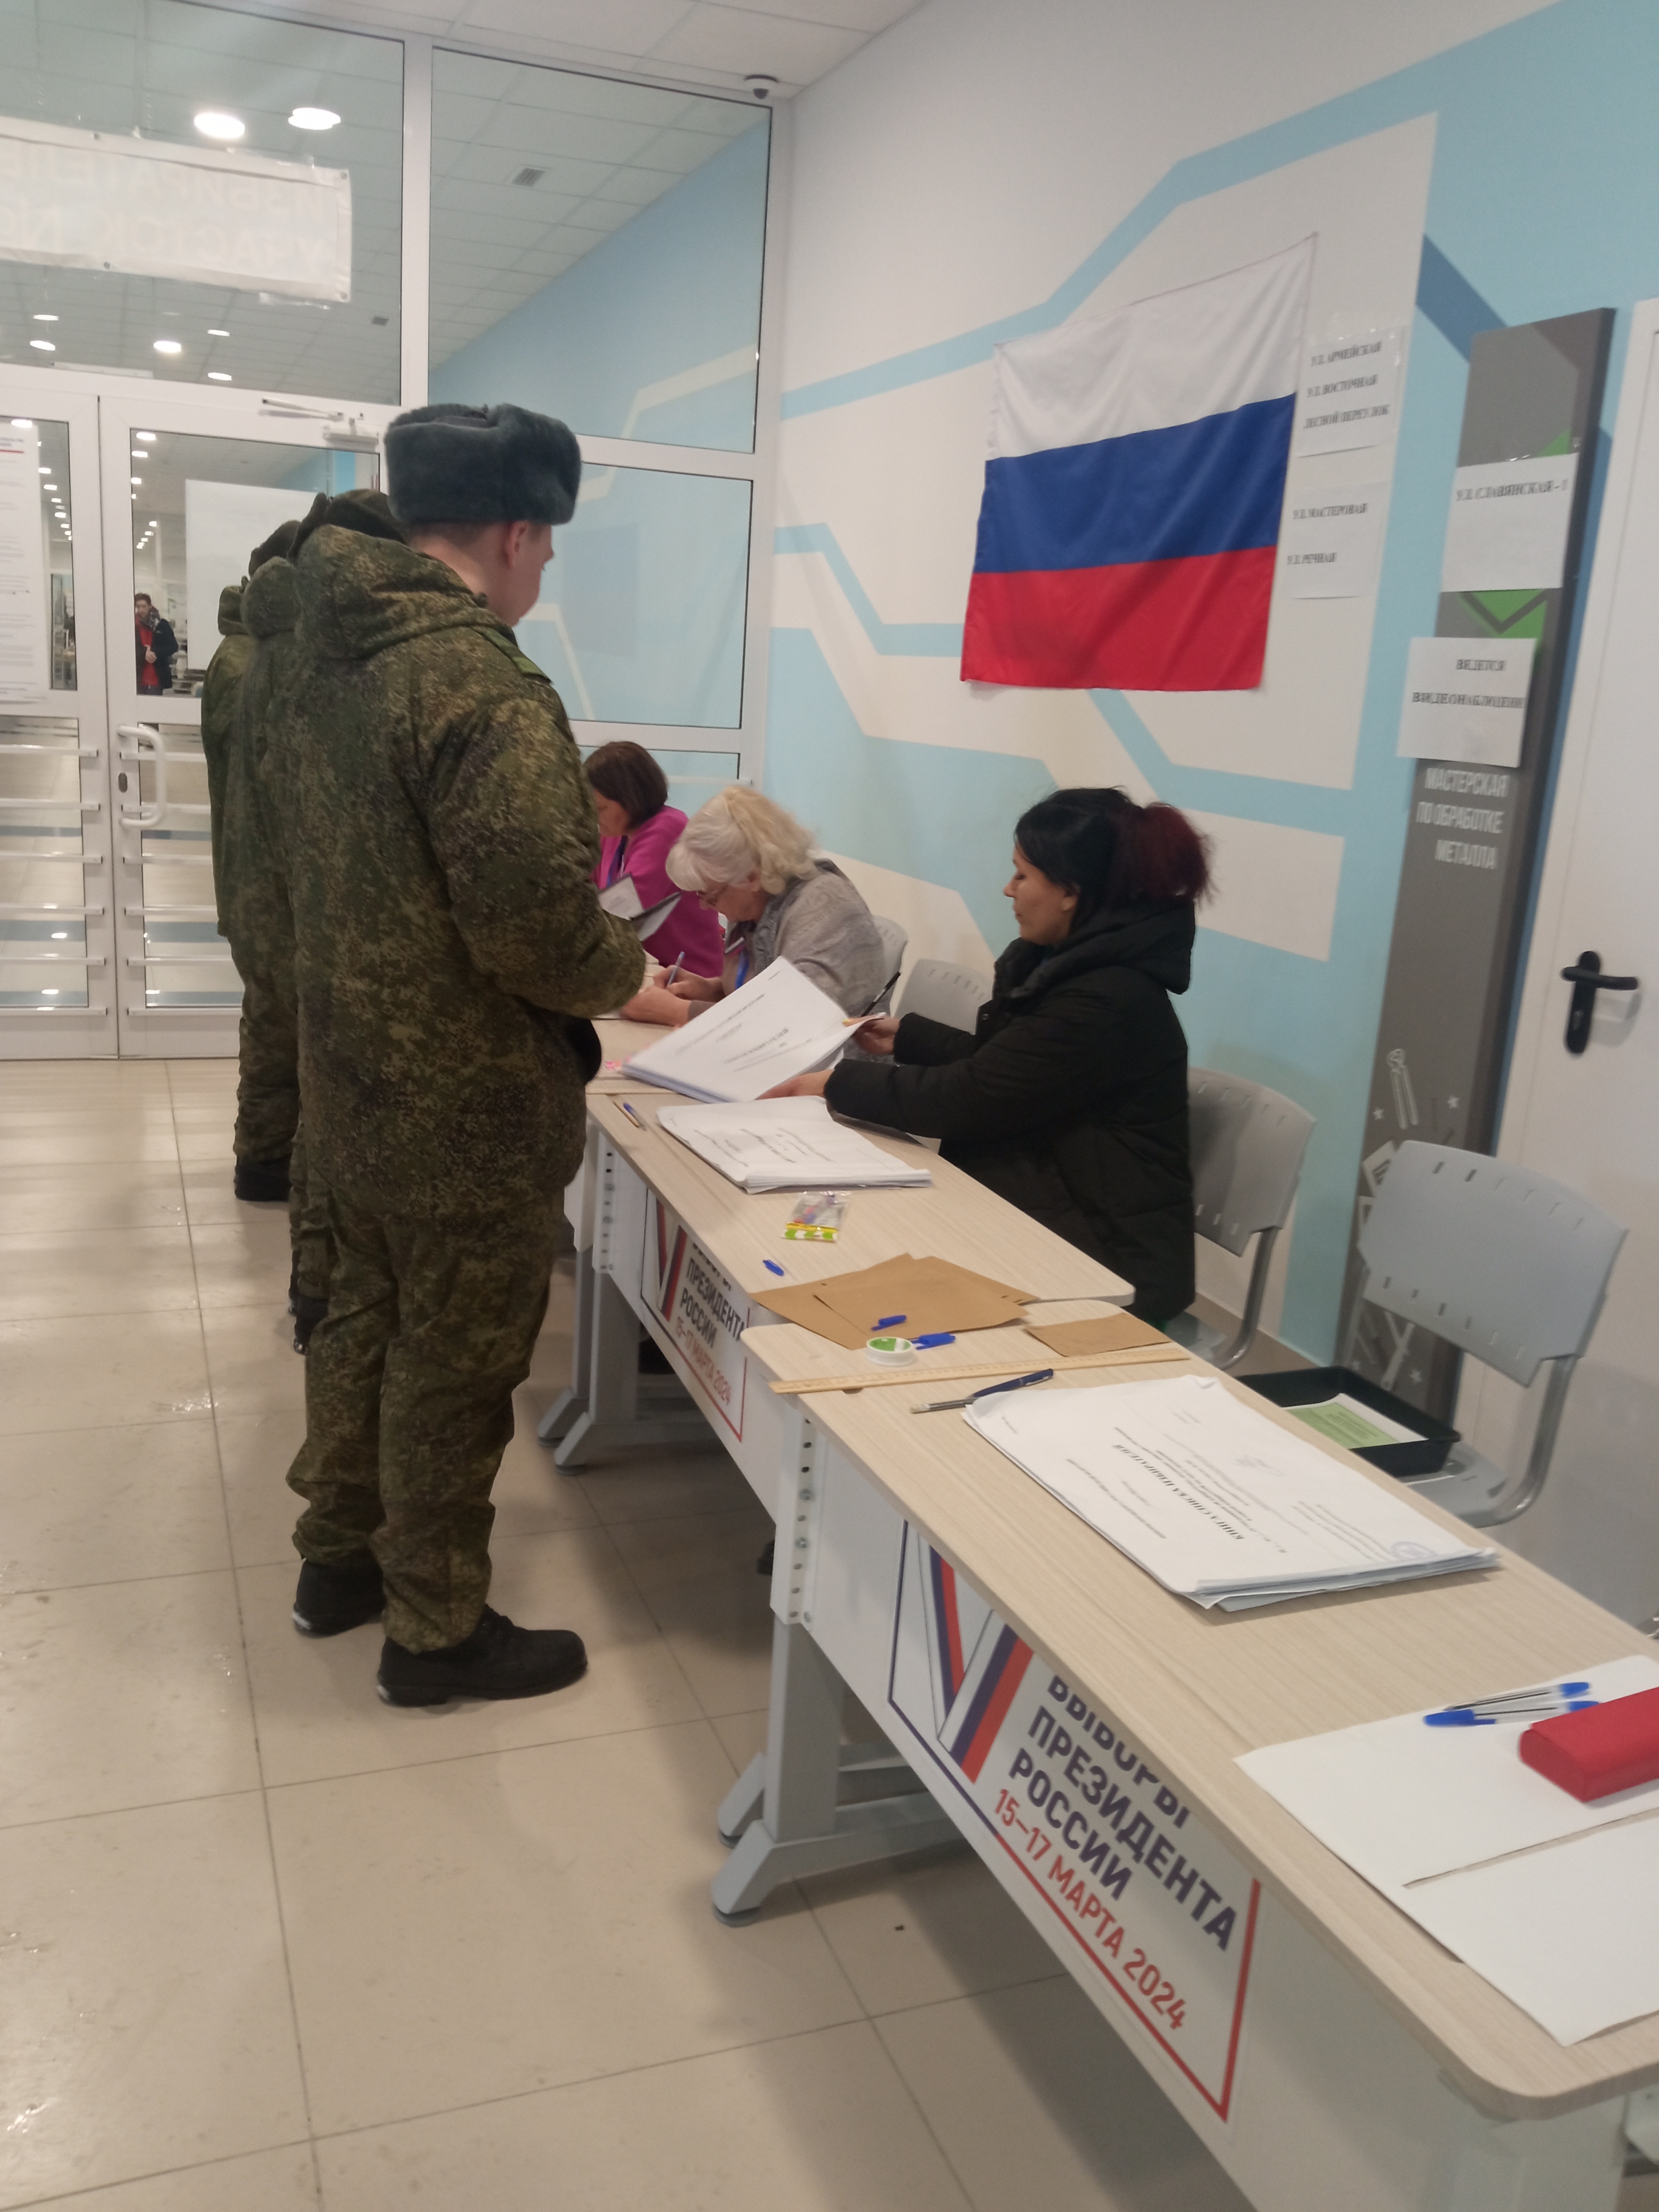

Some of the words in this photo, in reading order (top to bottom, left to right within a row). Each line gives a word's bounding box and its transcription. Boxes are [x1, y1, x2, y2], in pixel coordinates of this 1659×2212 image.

[1415, 801, 1434, 824] ПО
[1435, 803, 1504, 834] ОБРАБОТКЕ
[1425, 768, 1509, 798] МАСТЕРСКАЯ
[681, 1287, 717, 1349] РОССИИ
[1009, 1747, 1133, 1901] РОССИИ
[1028, 1705, 1237, 1951] ПРЕЗИДЕНТА
[1048, 1855, 1125, 1959] МАРТА
[1122, 1948, 1186, 2030] 2024
